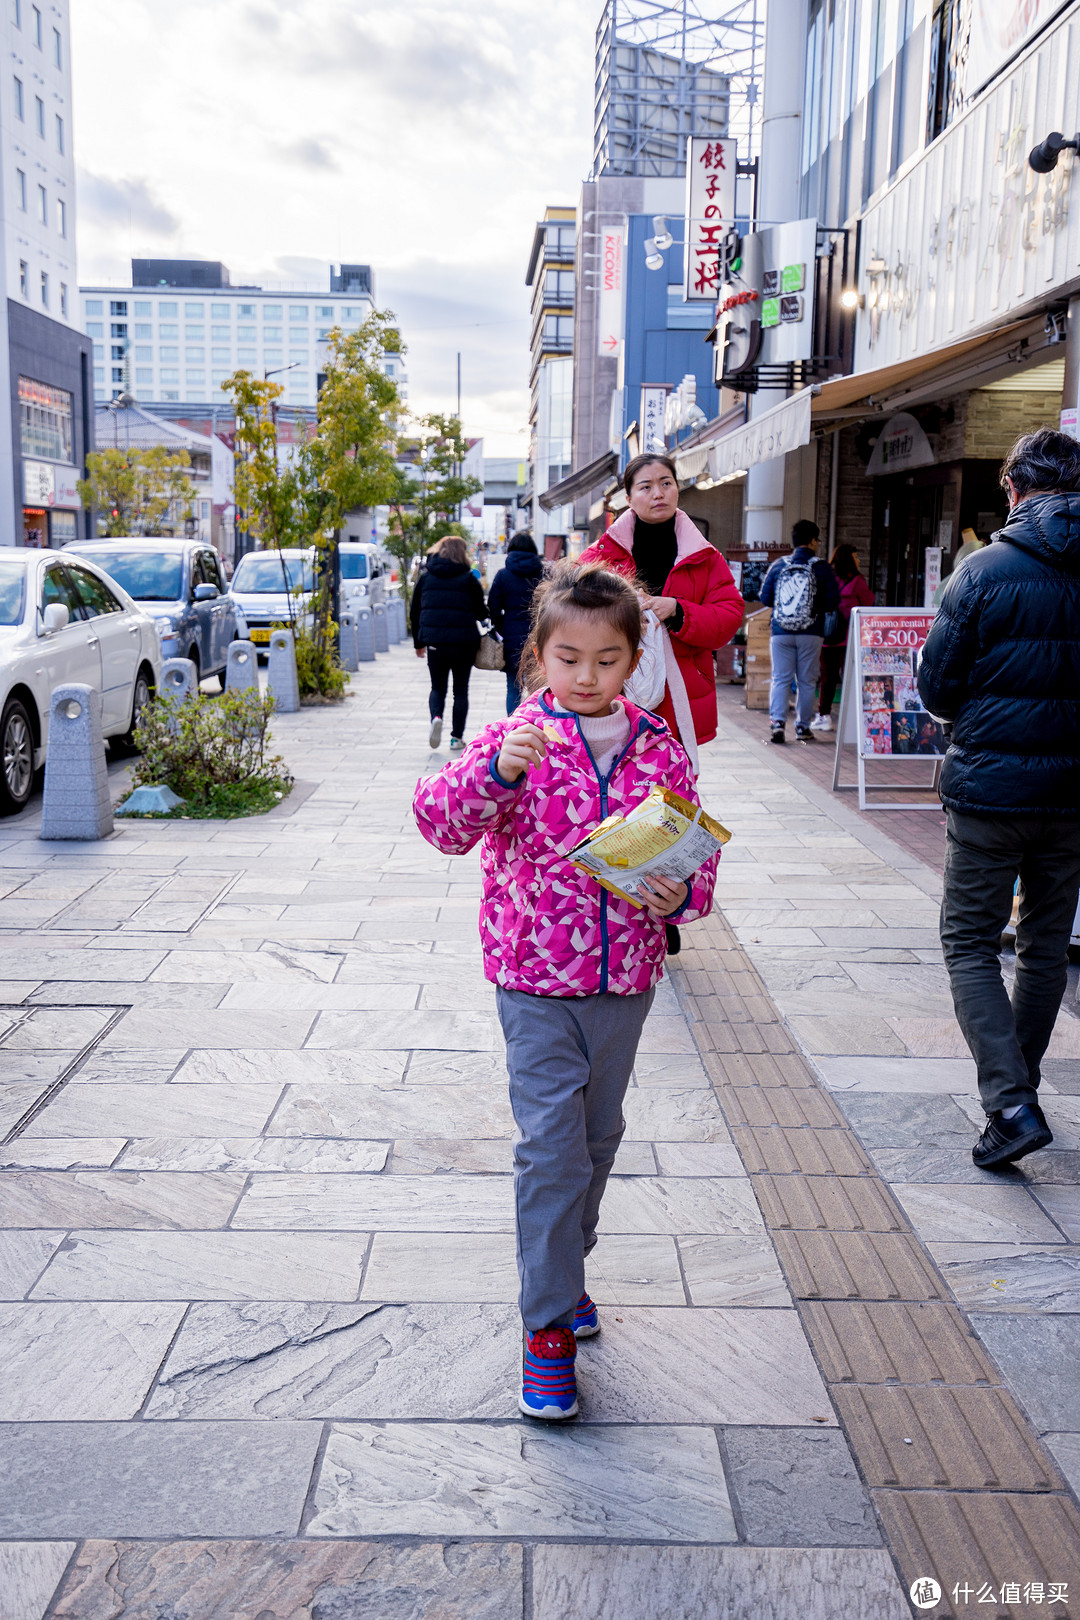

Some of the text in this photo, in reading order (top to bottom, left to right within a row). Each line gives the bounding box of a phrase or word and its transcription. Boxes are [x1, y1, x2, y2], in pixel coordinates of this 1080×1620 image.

[694, 141, 727, 296] 餃子の王将
[863, 618, 898, 628] Kimono
[900, 618, 926, 628] rental
